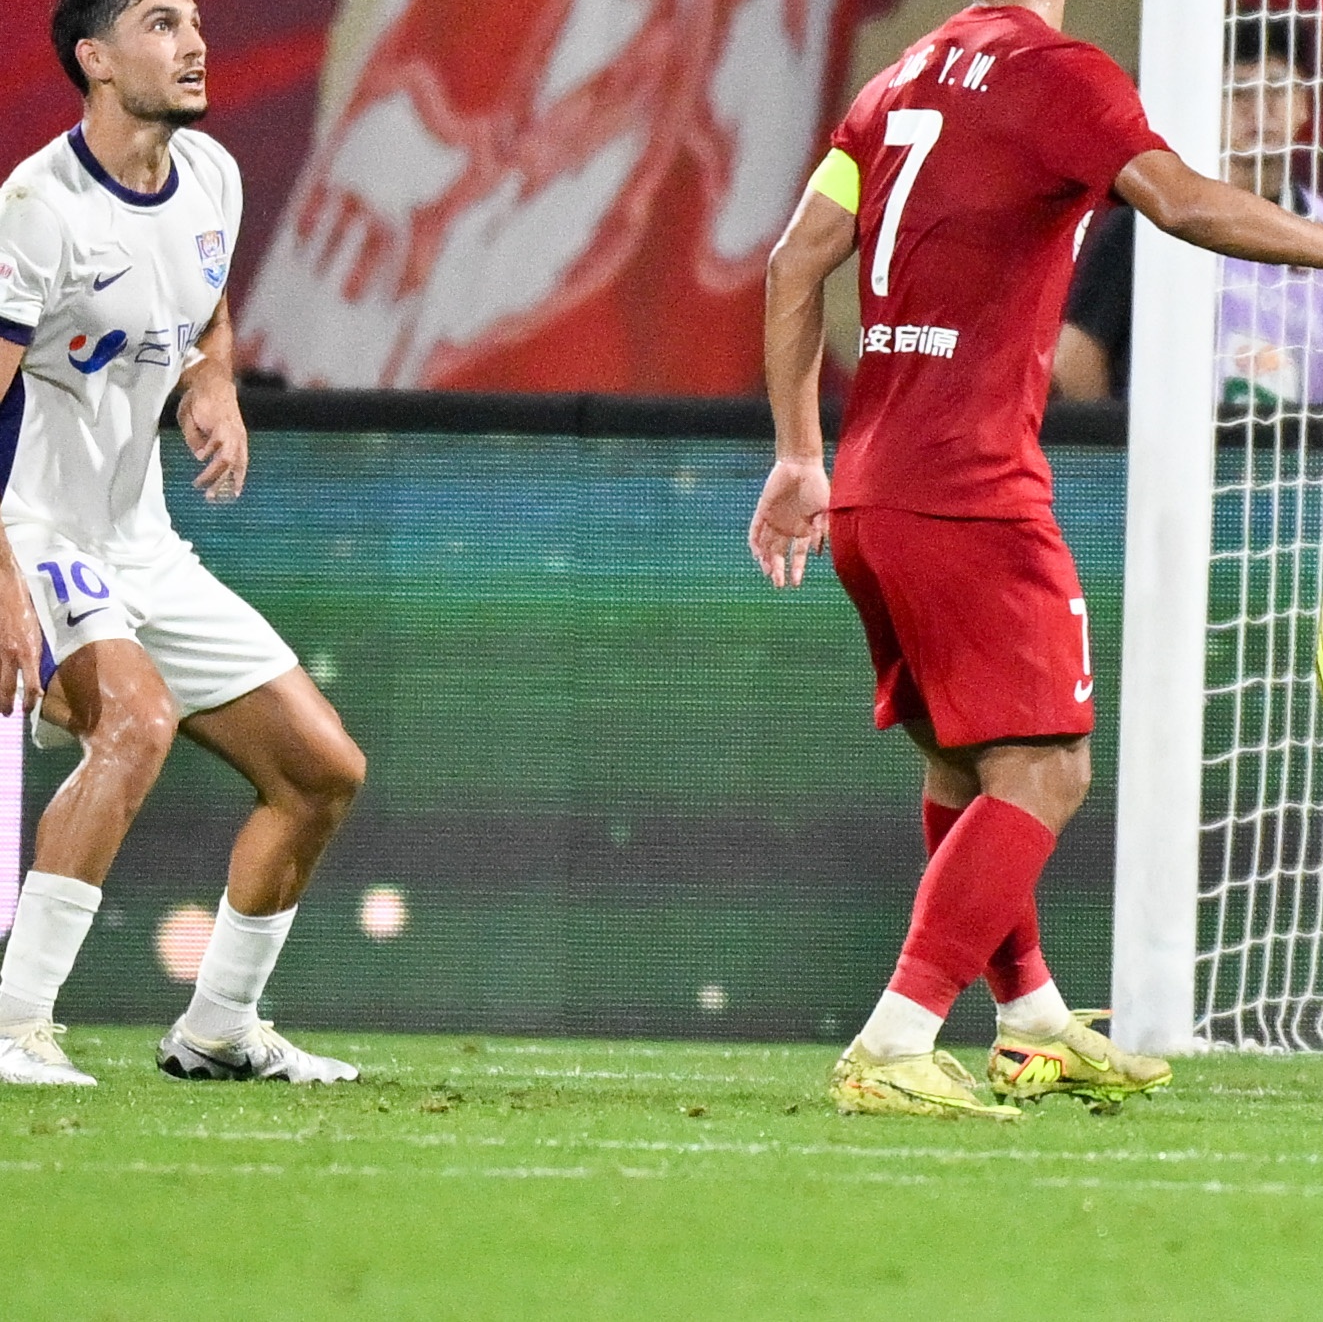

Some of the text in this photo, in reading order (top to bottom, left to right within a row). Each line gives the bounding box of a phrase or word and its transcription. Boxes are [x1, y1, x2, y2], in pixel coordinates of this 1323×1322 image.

[870, 108, 944, 296] 7
[864, 323, 960, 359] 安启源
[36, 560, 110, 604] 10
